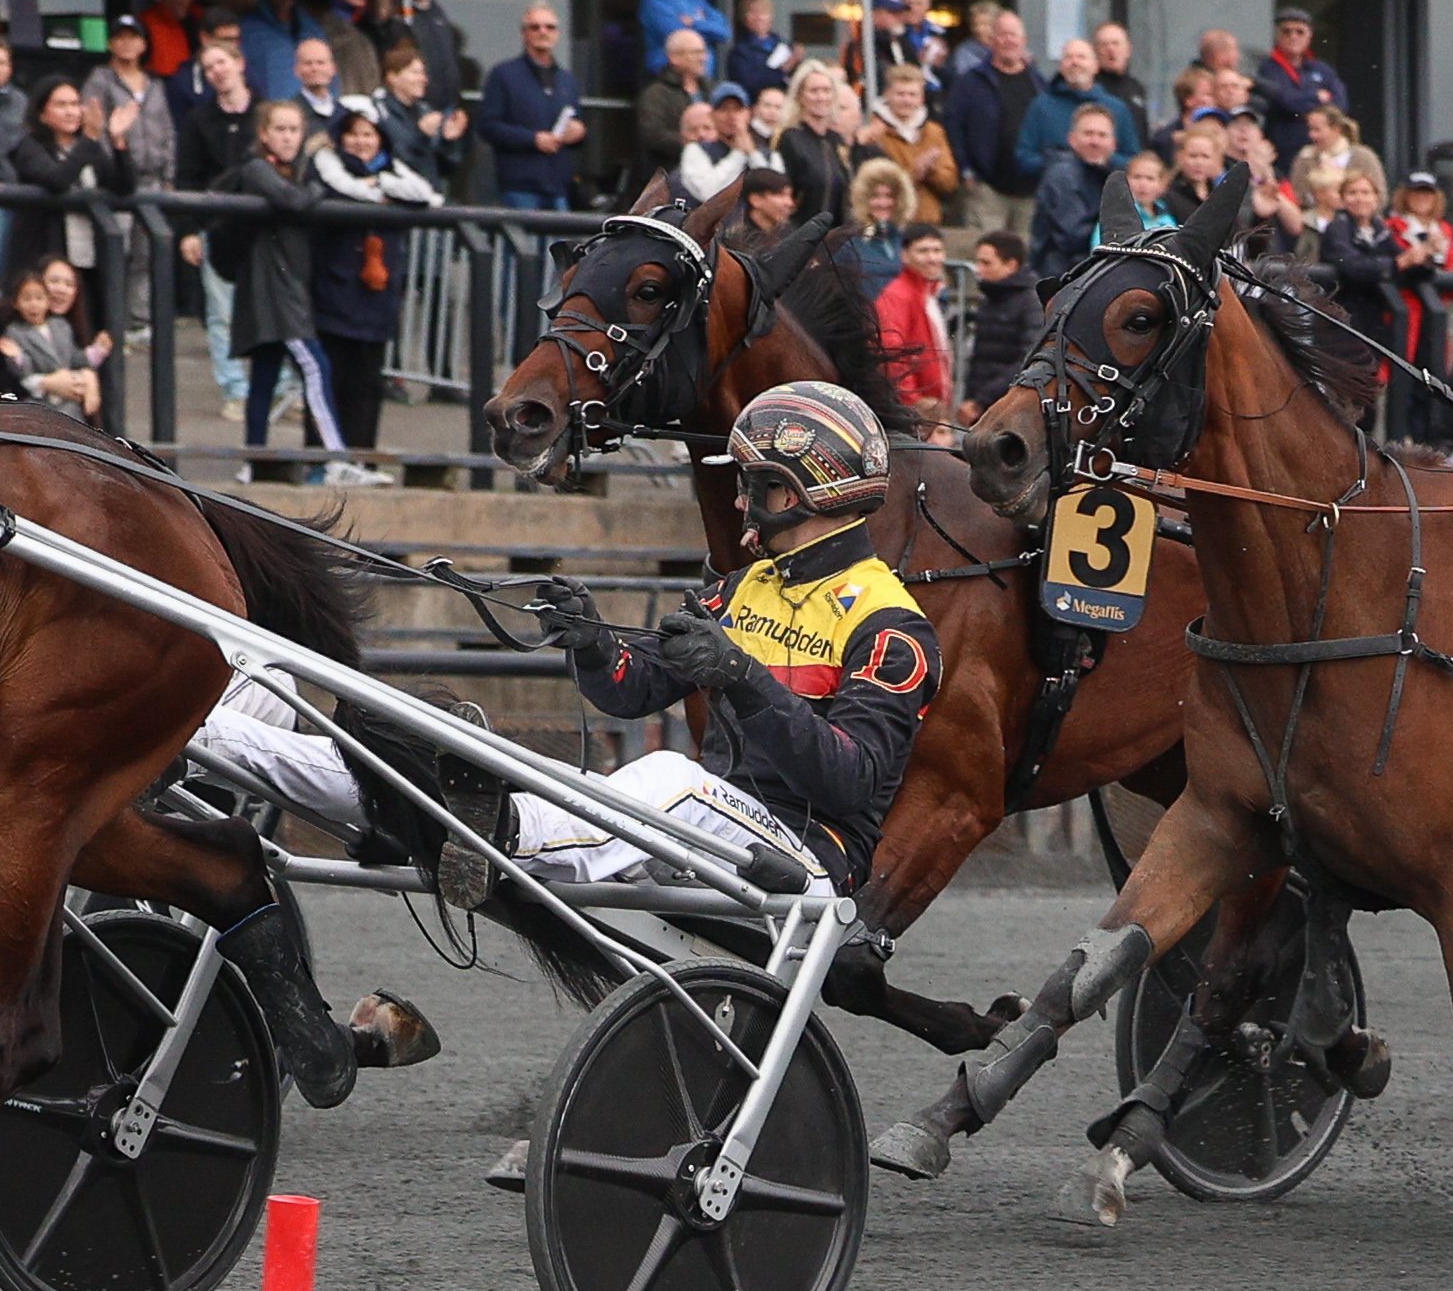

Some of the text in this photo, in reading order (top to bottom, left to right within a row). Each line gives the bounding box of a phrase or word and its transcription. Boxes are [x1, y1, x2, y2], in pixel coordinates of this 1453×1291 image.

[1069, 488, 1135, 588] 3
[735, 604, 833, 662] Ramudden
[1072, 598, 1125, 620] Megaflis
[851, 628, 928, 694] D
[719, 784, 783, 840] Ramudden
